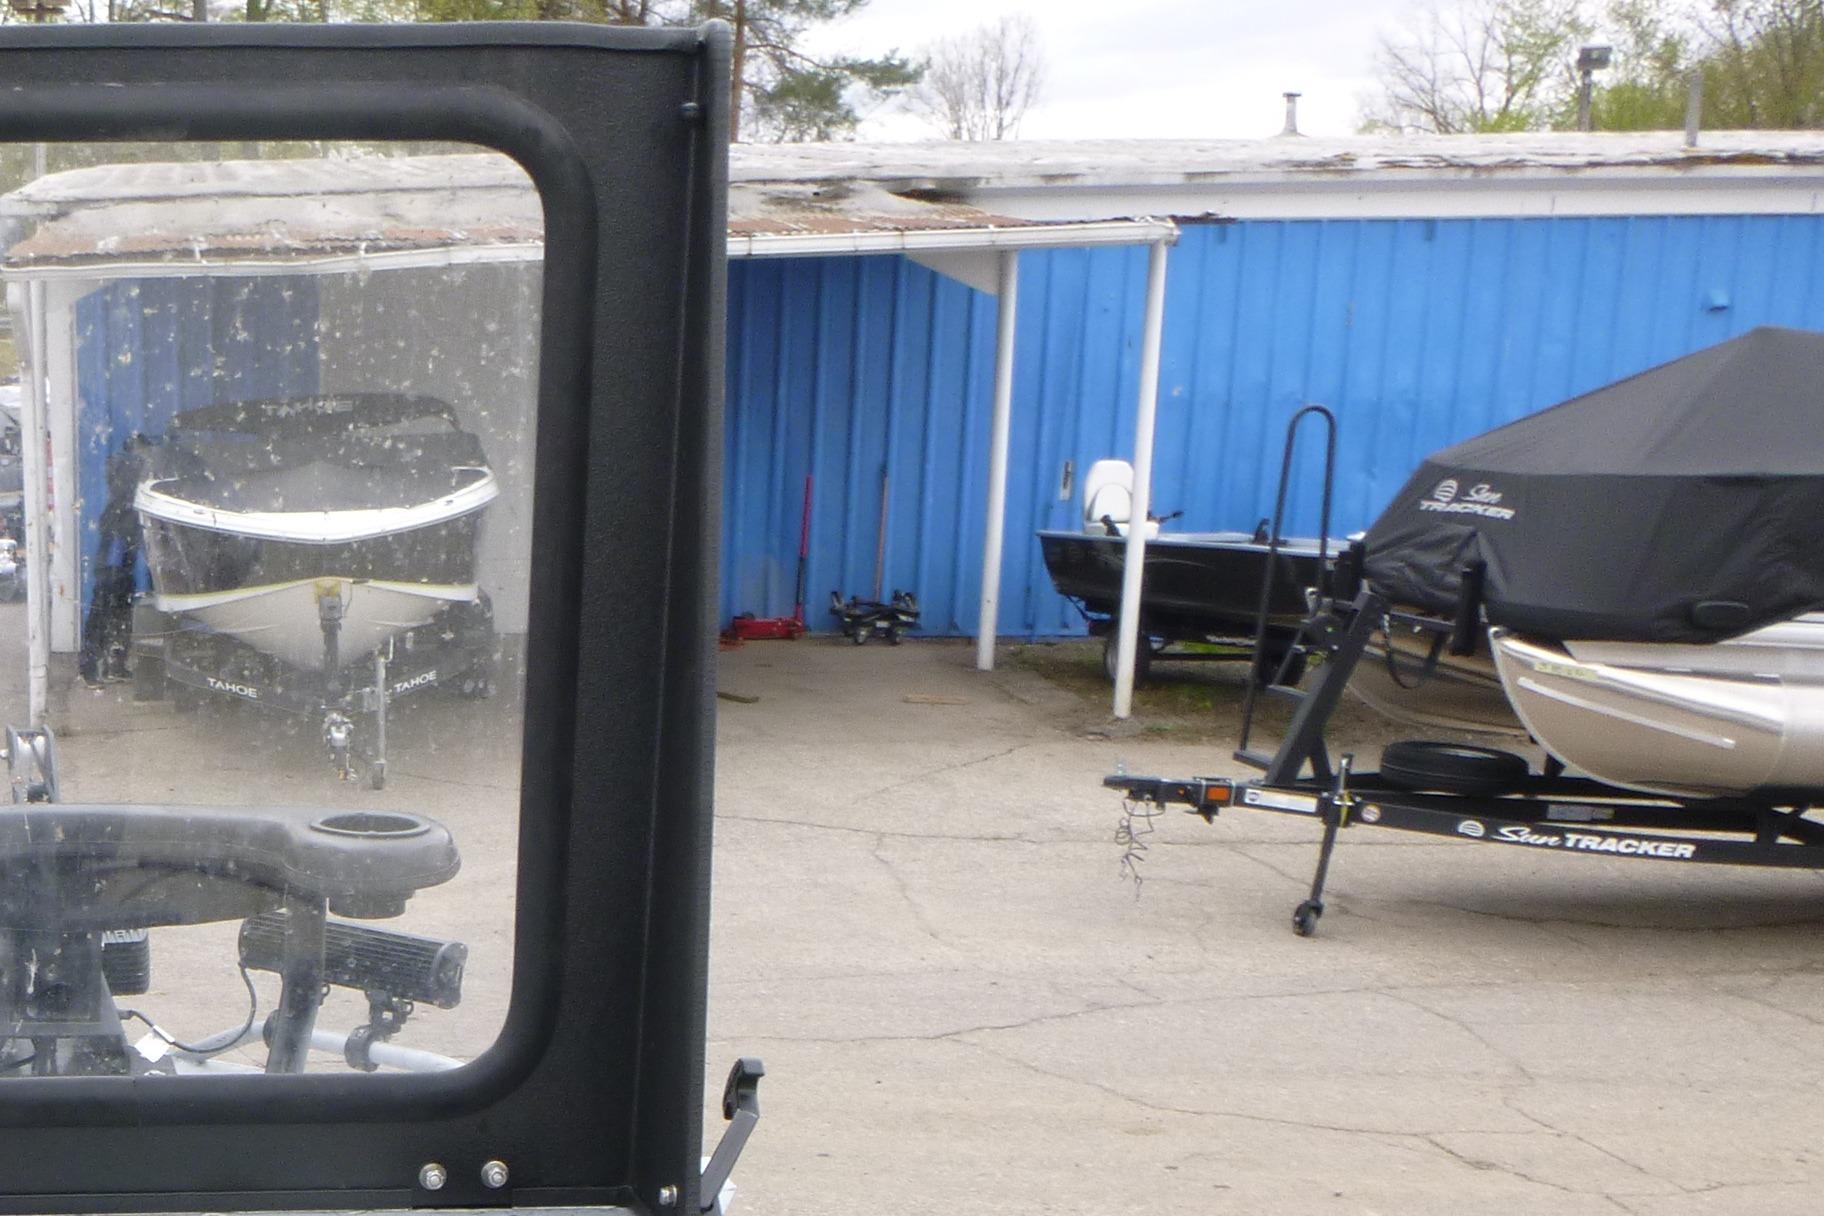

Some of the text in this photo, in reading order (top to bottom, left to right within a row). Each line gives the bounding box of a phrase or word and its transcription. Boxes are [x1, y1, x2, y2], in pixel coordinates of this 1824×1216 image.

[1420, 500, 1515, 520] TRACKER
[206, 677, 258, 698] TAHOE
[394, 670, 437, 693] TAHOE
[1489, 826, 1697, 858] Sun TRACKER
